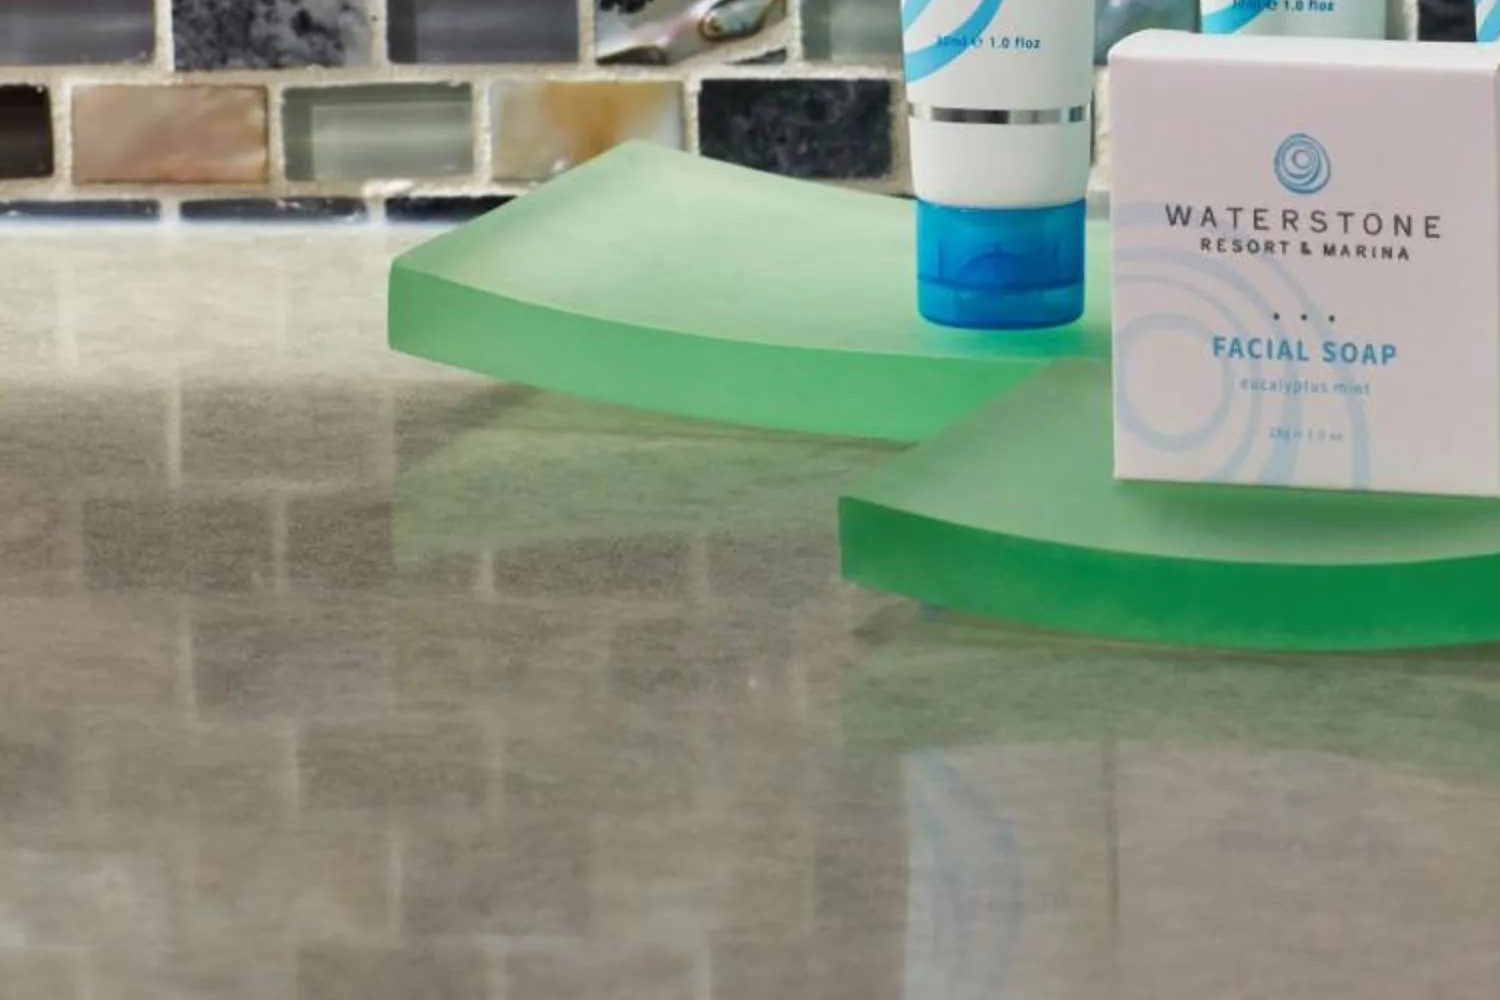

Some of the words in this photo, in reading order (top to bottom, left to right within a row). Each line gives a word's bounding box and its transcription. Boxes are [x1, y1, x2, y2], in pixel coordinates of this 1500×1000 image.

[1165, 203, 1442, 239] WATERSTONE
[1200, 237, 1291, 256] RESORT
[1300, 241, 1312, 255] &
[1323, 244, 1410, 261] MARINA
[1213, 335, 1310, 362] FACIAL
[1322, 341, 1397, 366] SOAP
[1239, 377, 1328, 395] eucalyptus
[1333, 380, 1371, 396] mint
